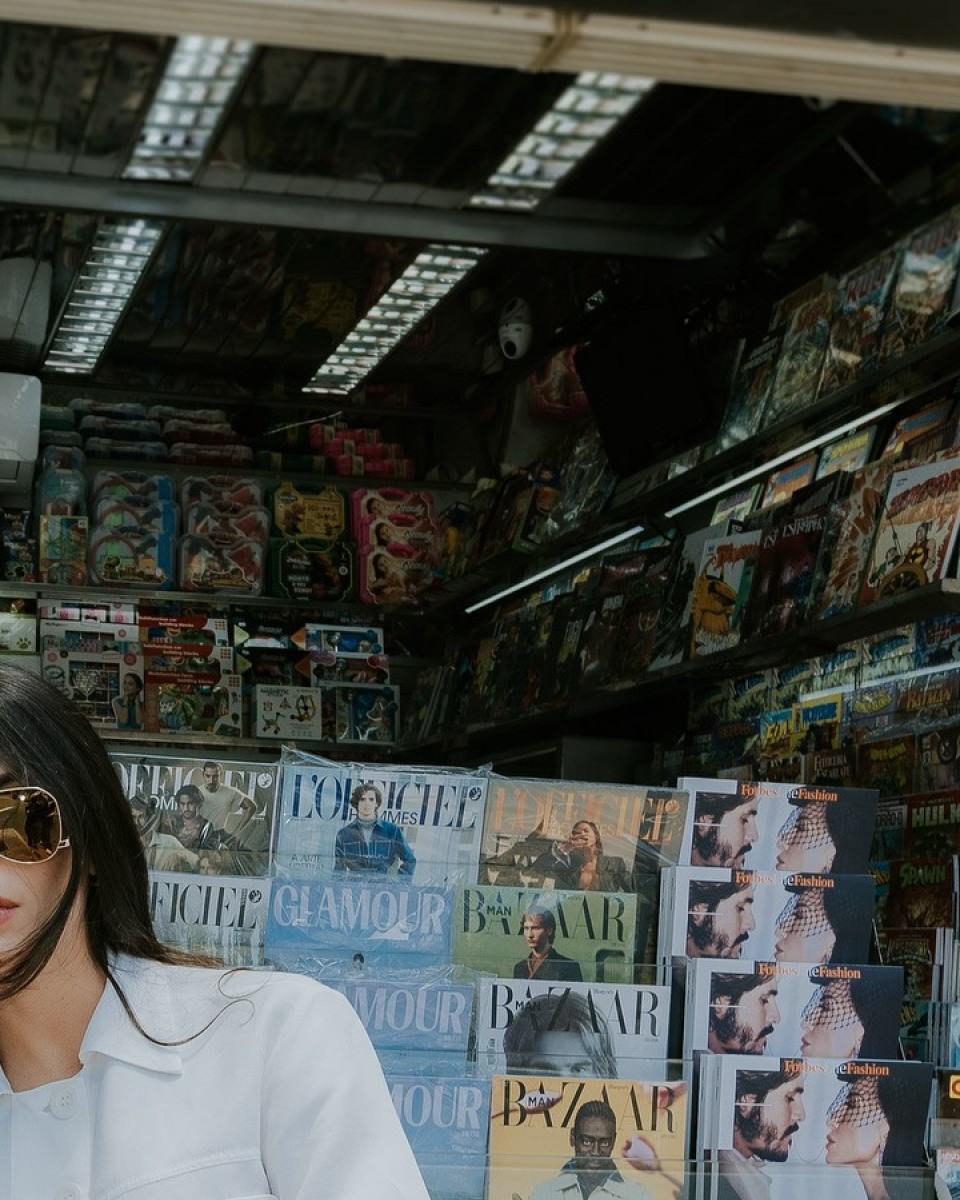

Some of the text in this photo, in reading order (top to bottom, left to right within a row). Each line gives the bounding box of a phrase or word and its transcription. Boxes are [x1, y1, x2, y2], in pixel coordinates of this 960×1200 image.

[741, 785, 777, 797] Forbes
[349, 810, 417, 825] HMMES
[735, 871, 773, 884] Forbes
[273, 884, 445, 935] GLAMOUR
[487, 906, 512, 916] MAN
[759, 963, 798, 975] Forbes
[783, 1060, 825, 1073] Forbes
[504, 1079, 675, 1134] BAZAAR
[528, 1096, 557, 1107] MAN
